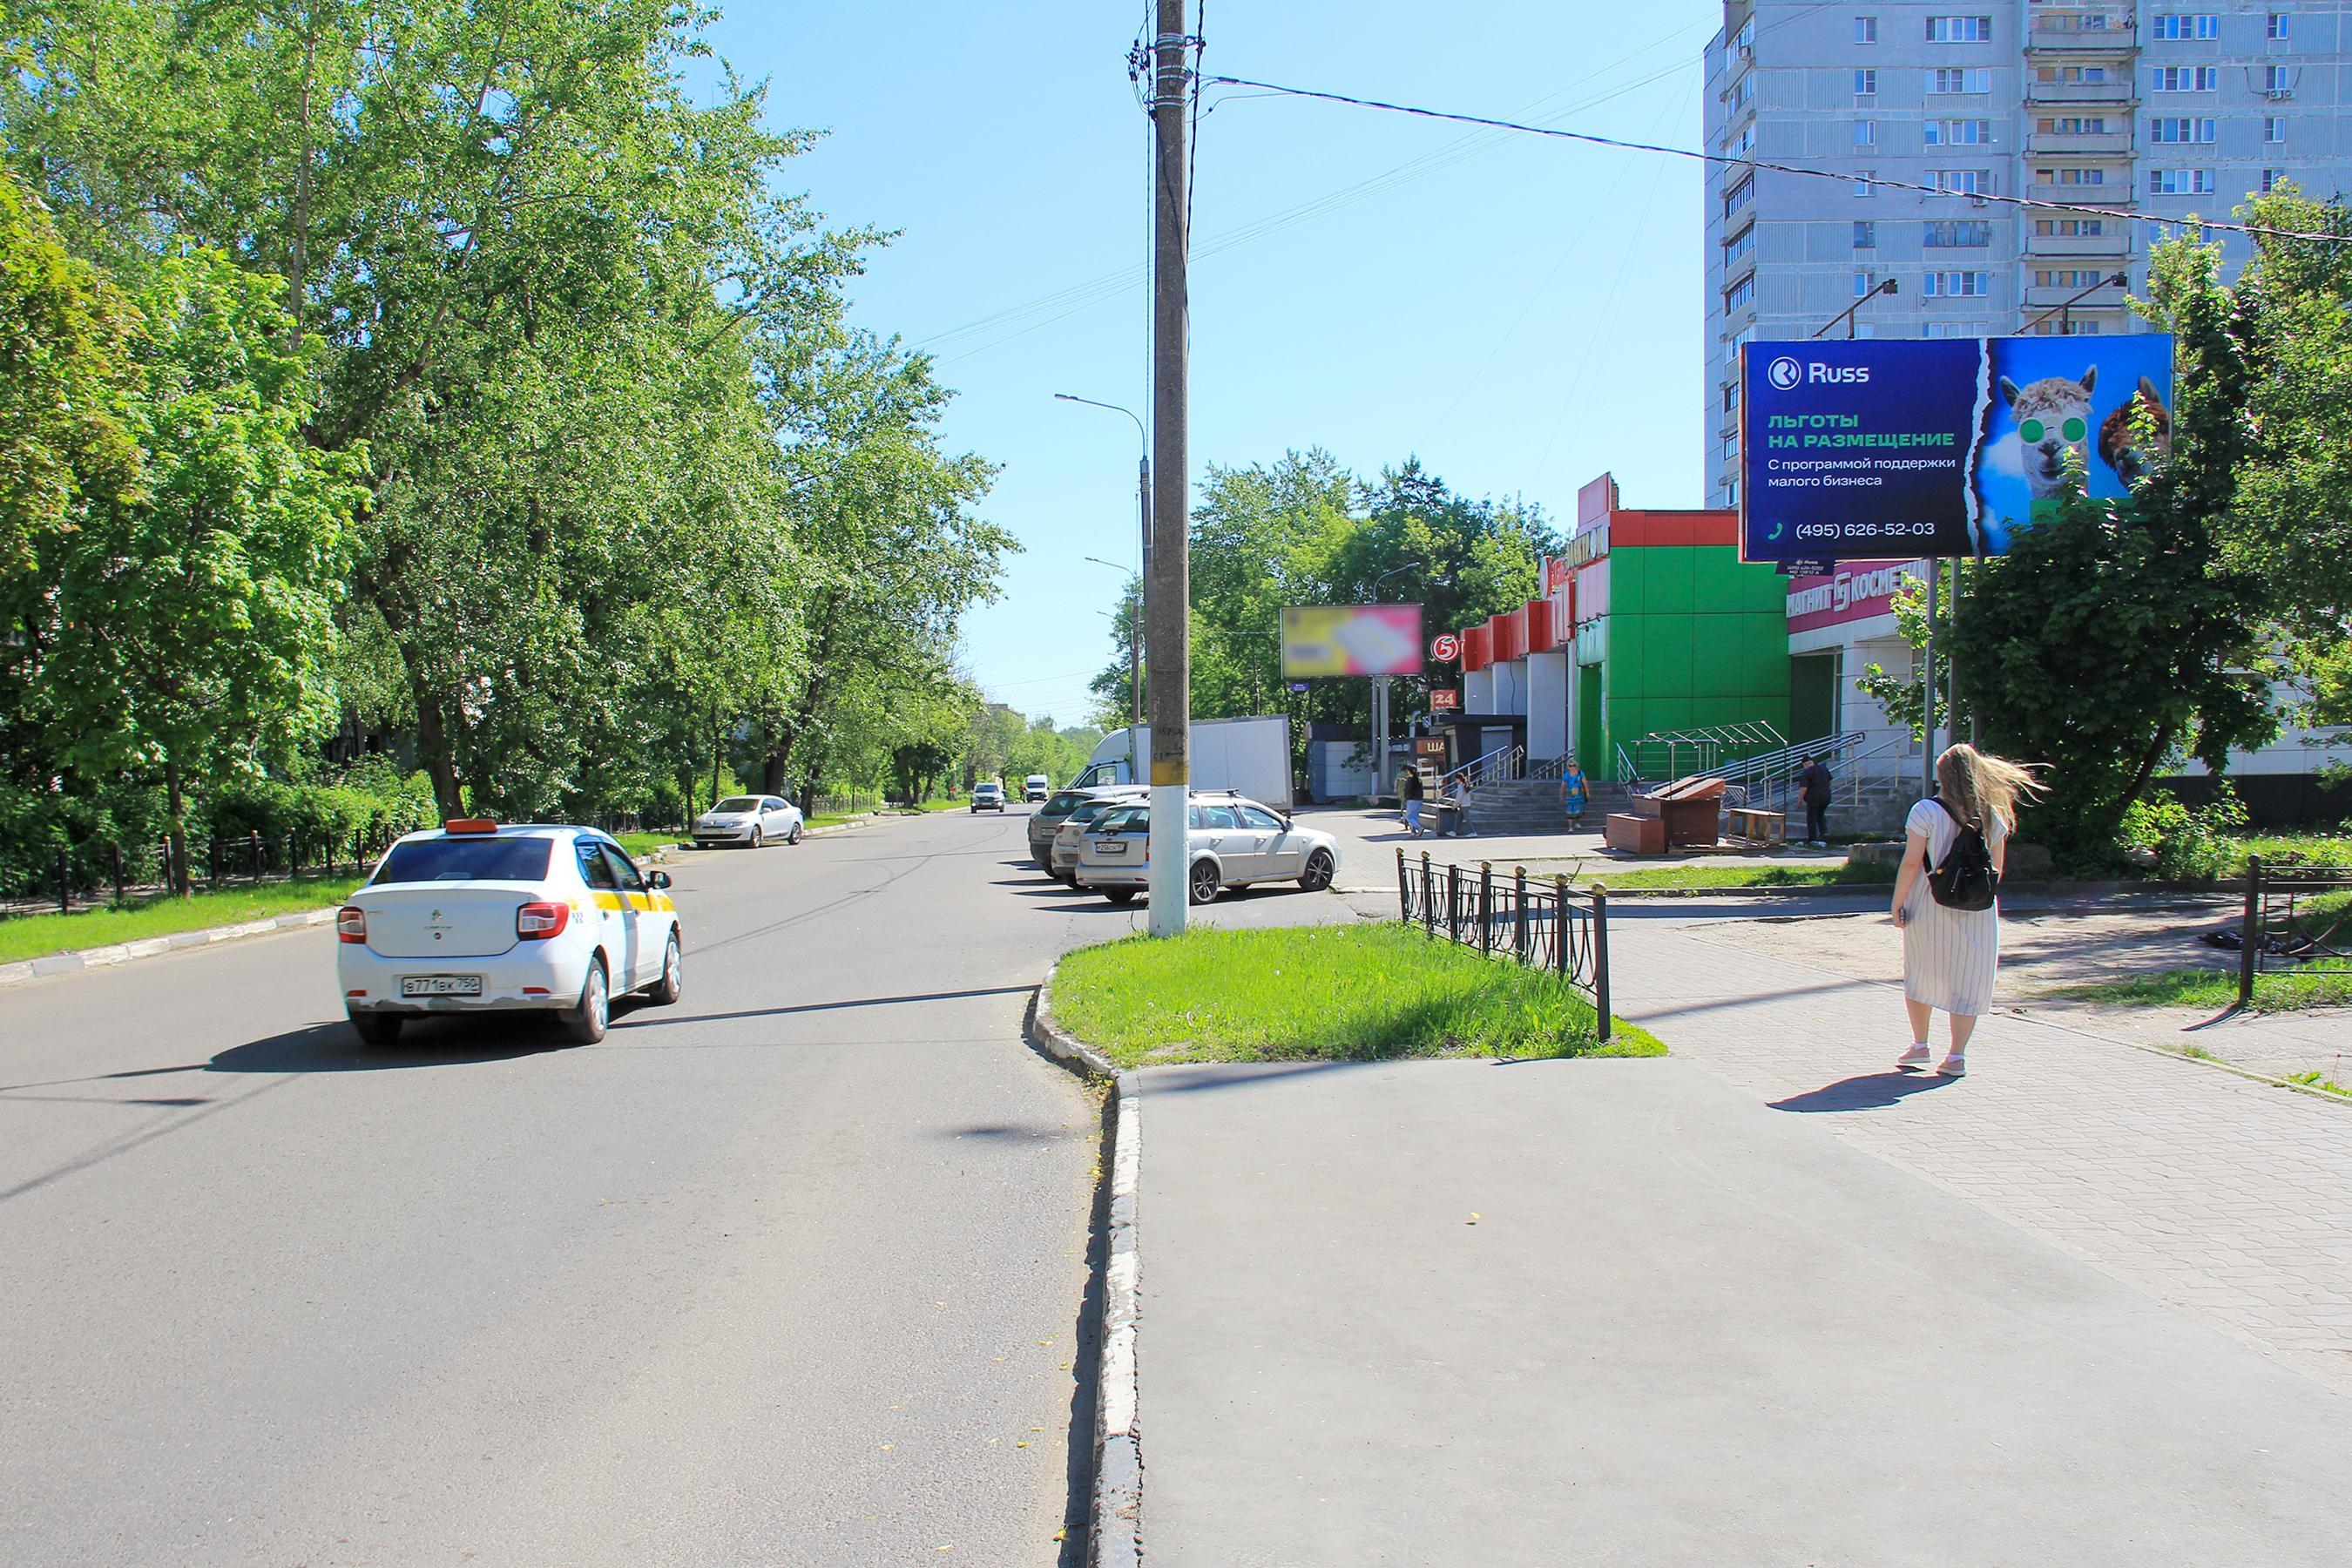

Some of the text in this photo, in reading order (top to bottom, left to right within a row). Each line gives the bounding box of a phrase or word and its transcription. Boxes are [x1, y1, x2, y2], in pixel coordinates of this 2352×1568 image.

[1808, 362, 1869, 383] Russ
[1767, 414, 1859, 429] ЛЬГОТЫ
[1768, 433, 1956, 449] НА РАЗМЕЩЕНИЕ
[1767, 456, 1957, 473] С программой поддержки
[1767, 475, 1882, 488] малого бизнеса
[1795, 523, 1936, 540] (495) 626-52-03
[1786, 558, 1931, 618] МАГНИТ КОСМЕТИК
[1435, 693, 1454, 705] 24
